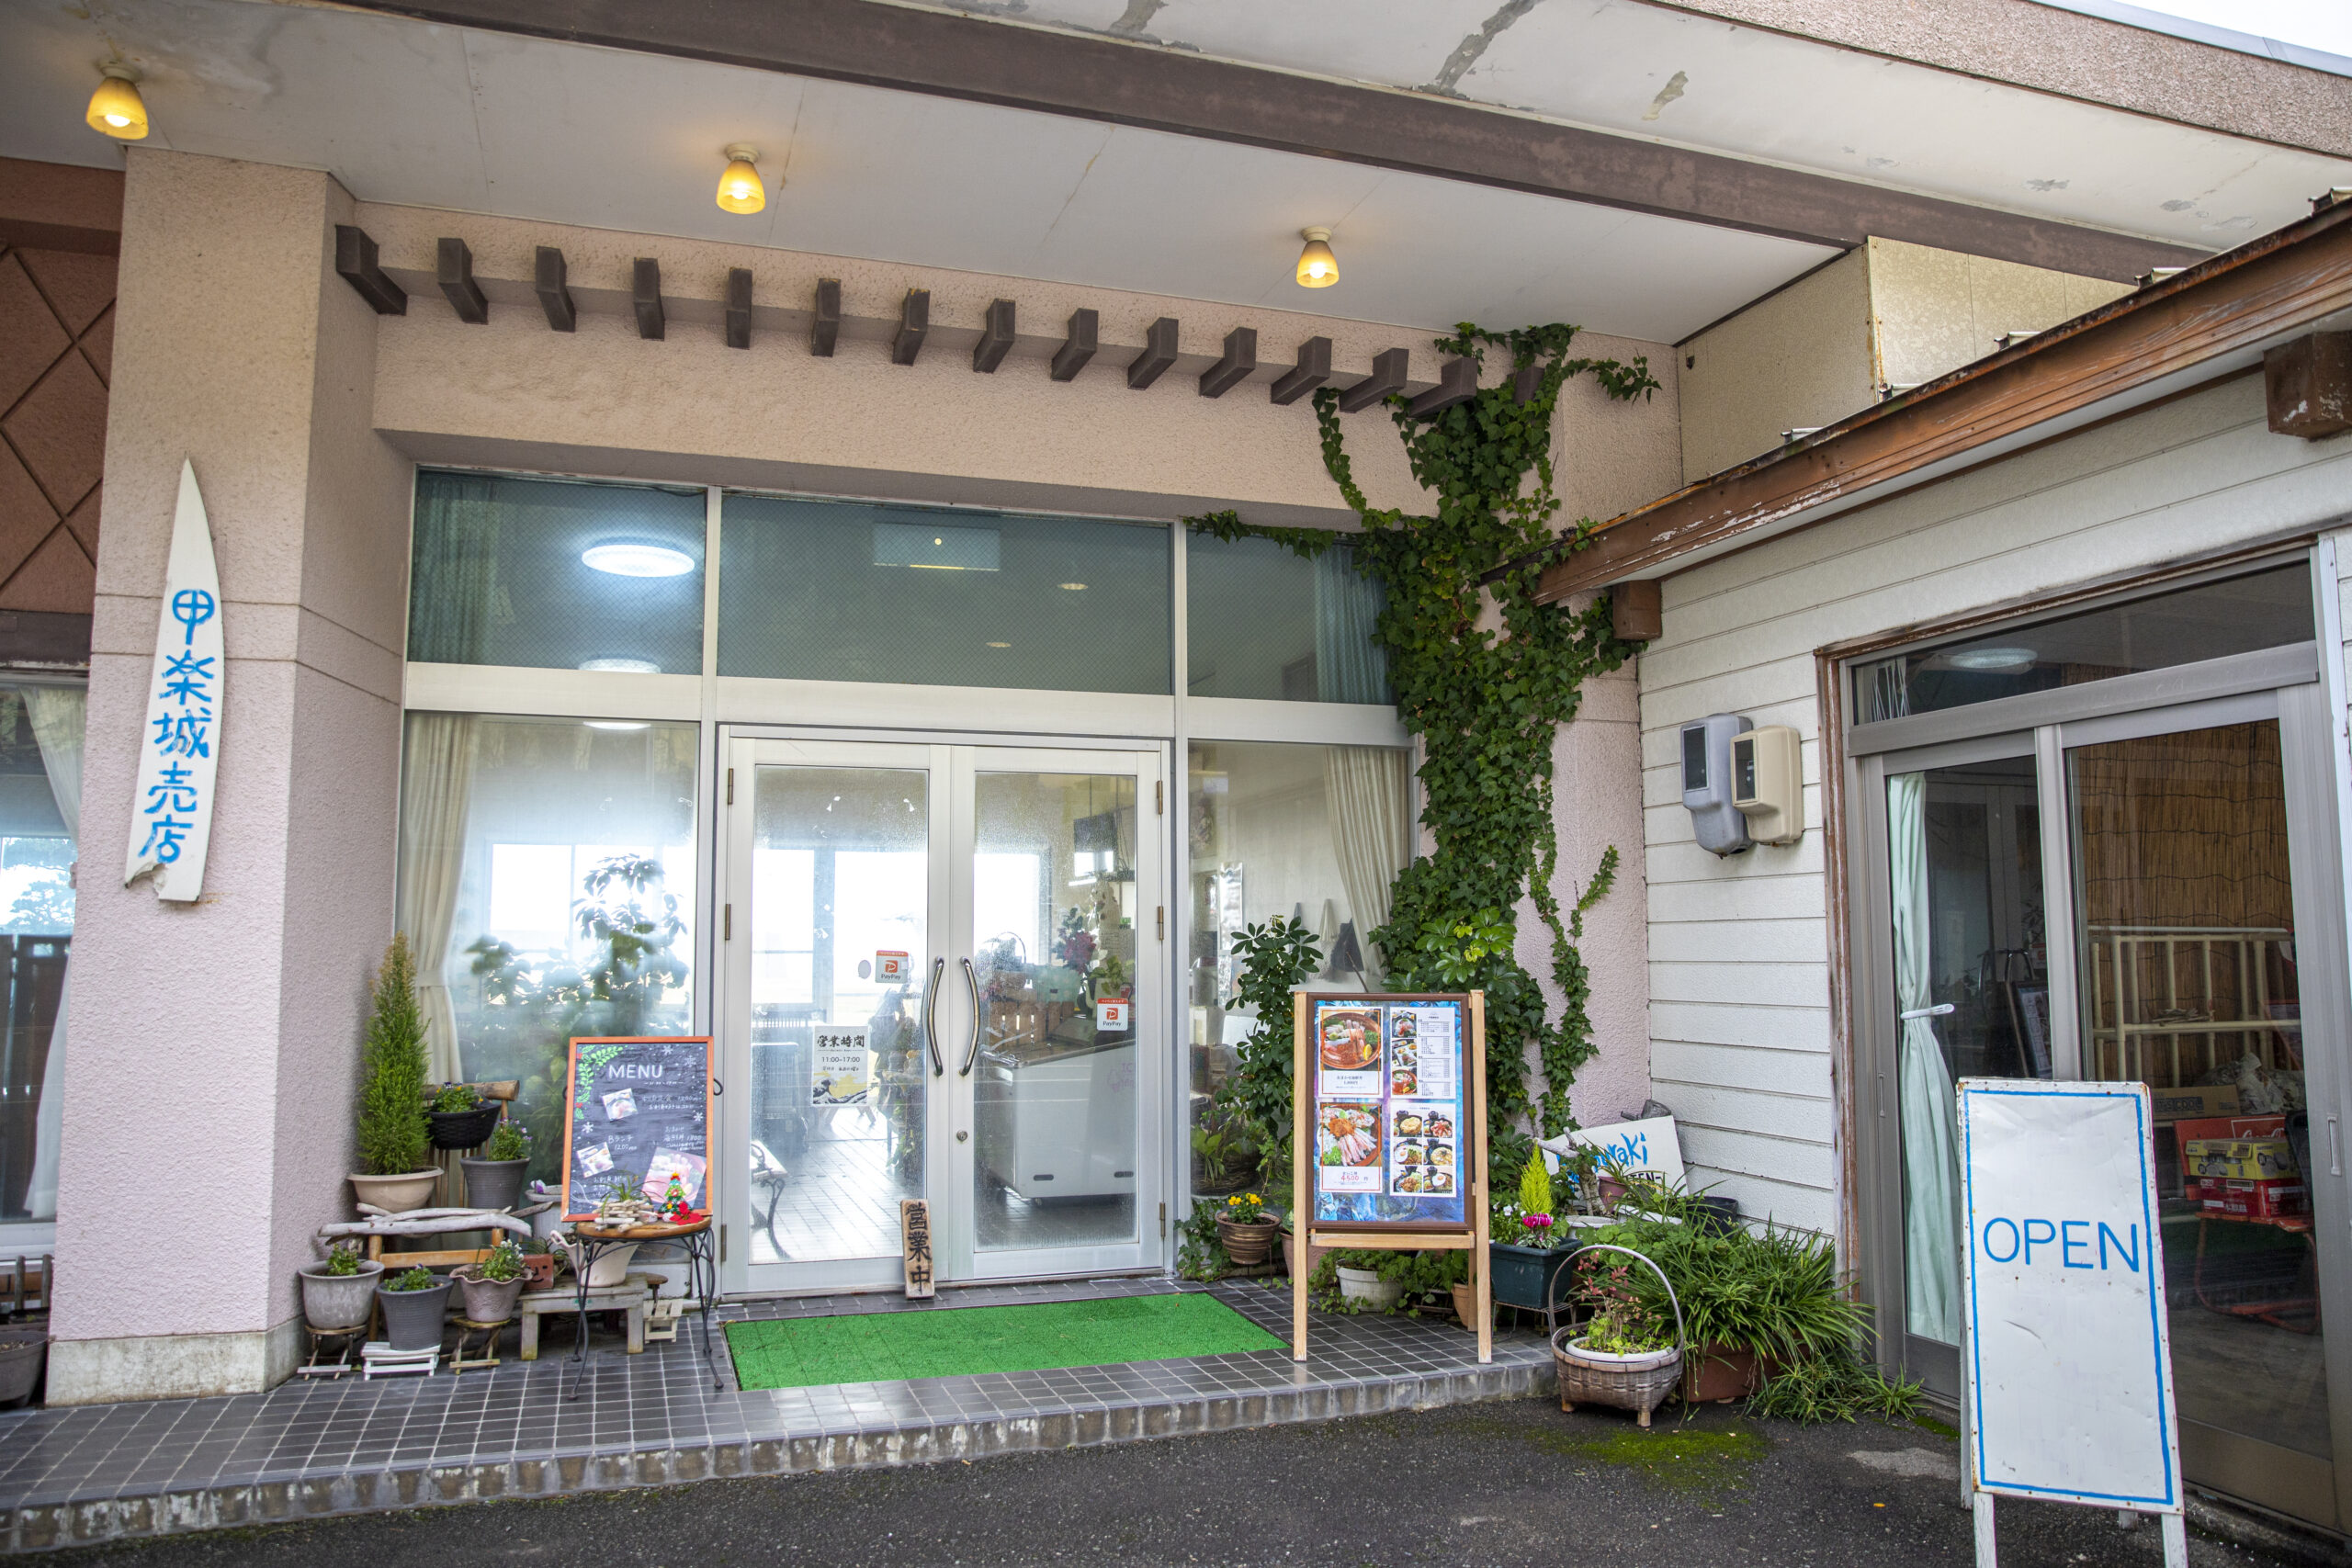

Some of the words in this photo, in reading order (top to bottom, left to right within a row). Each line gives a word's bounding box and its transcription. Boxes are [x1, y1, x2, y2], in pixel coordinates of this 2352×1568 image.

[138, 589, 215, 864] 甲楽城売店
[608, 1064, 663, 1079] MENU
[905, 1201, 932, 1294] 営業中
[1983, 1217, 2140, 1272] OPEN
